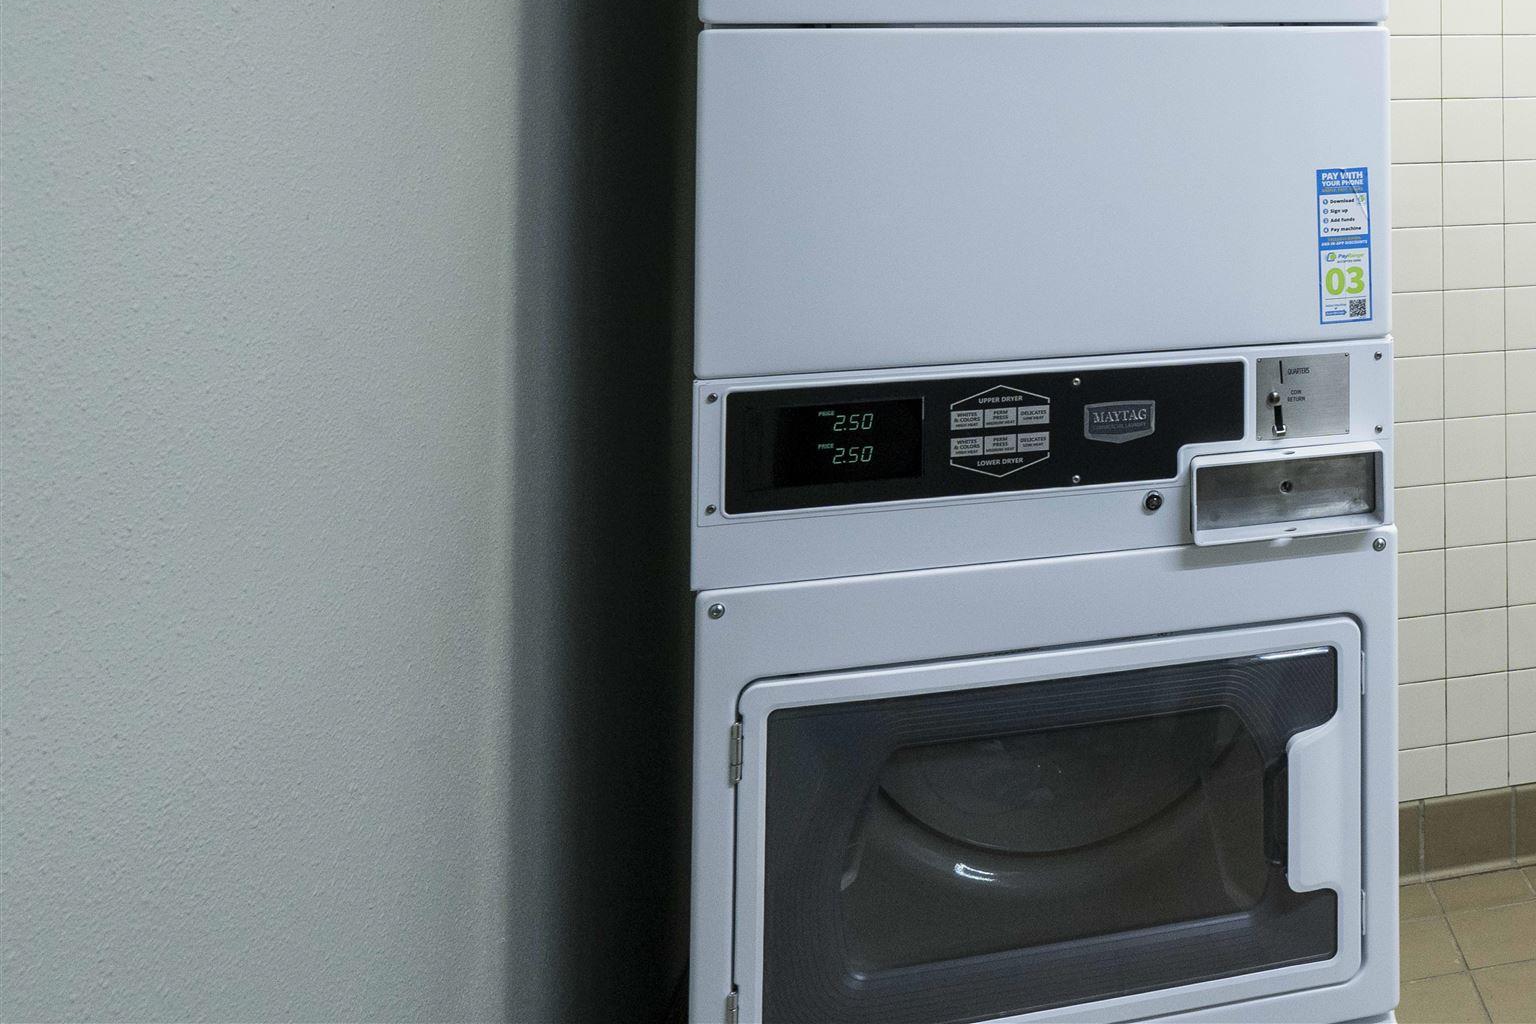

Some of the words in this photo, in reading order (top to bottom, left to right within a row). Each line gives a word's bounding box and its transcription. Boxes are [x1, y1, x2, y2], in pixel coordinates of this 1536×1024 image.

[1322, 172, 1338, 181] PAY
[1340, 171, 1363, 179] WITH
[1326, 266, 1365, 295] 03
[1288, 367, 1310, 375] QUARTERS
[833, 413, 873, 431] 2.50
[1093, 408, 1147, 423] MAYTAG
[832, 446, 873, 464] 2.50
